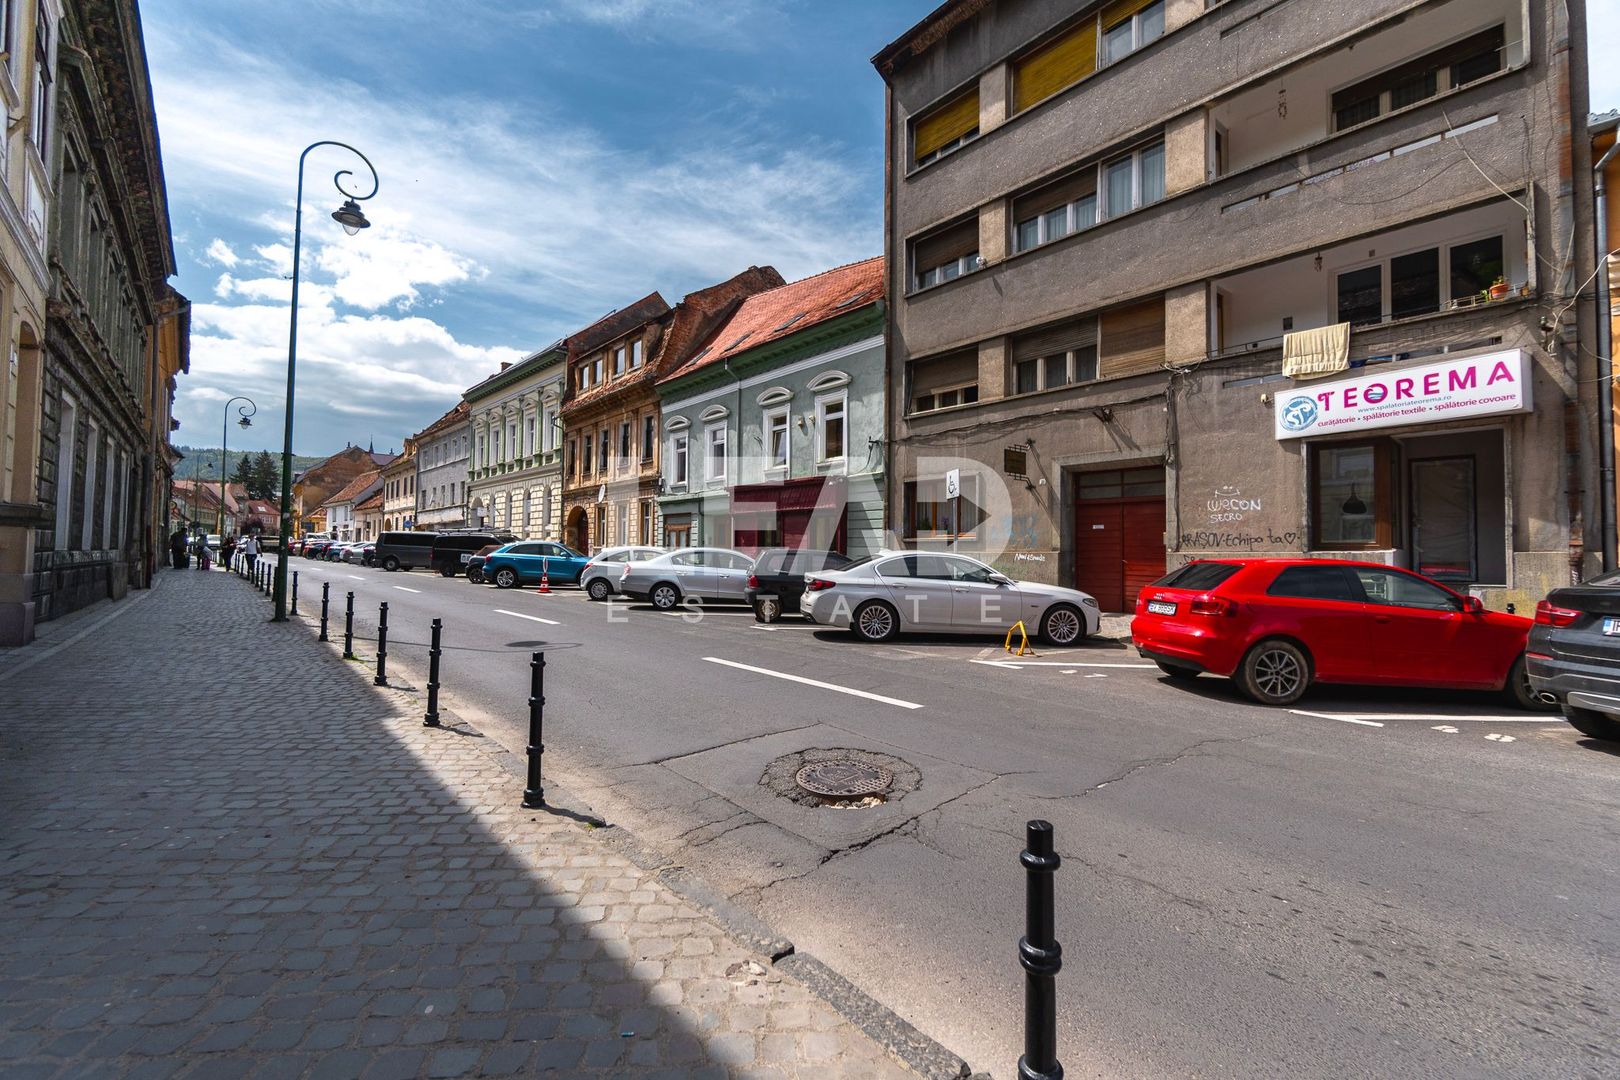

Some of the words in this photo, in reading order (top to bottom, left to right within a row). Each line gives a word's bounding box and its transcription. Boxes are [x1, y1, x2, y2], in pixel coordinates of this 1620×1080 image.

[1318, 361, 1515, 411] TEOREMA
[1358, 395, 1452, 413] www.spalatoriateorema.ro
[1401, 406, 1426, 415] textile
[1479, 393, 1516, 405] covoare
[1267, 528, 1283, 544] ta
